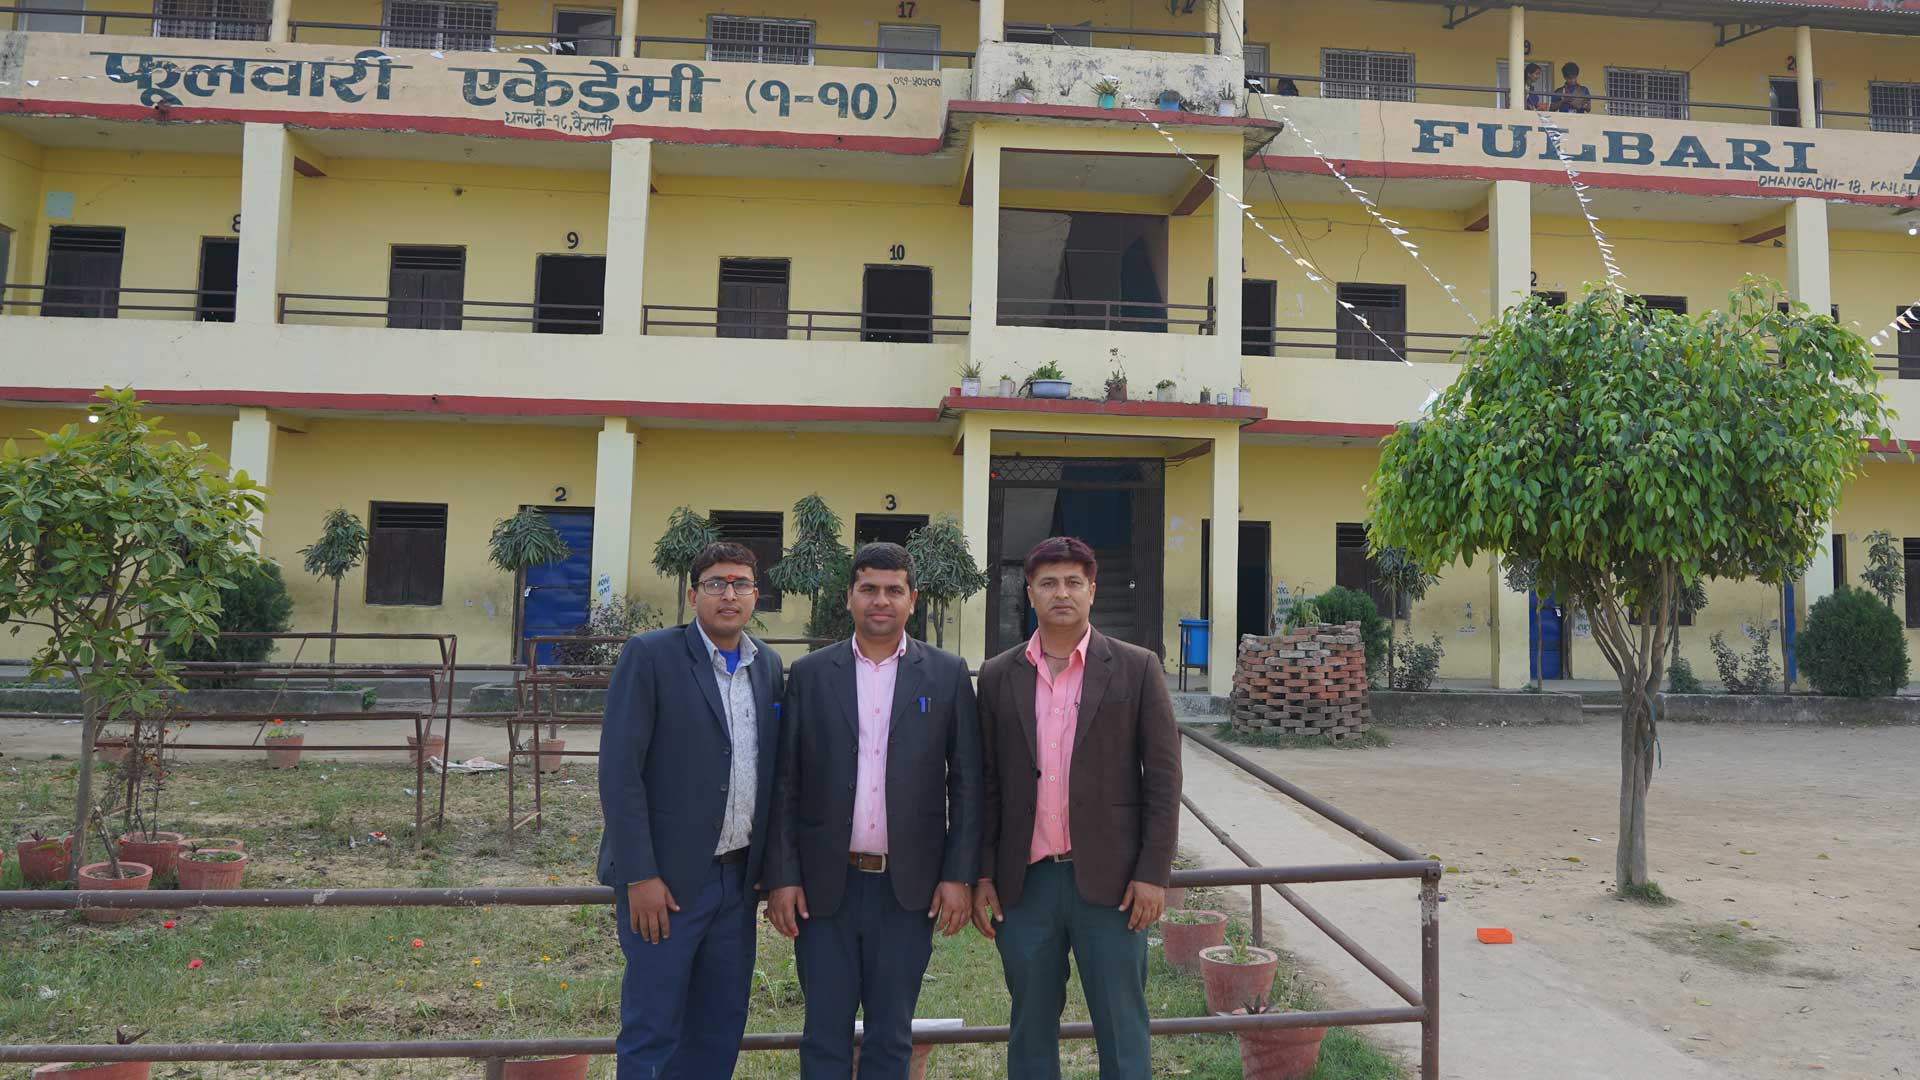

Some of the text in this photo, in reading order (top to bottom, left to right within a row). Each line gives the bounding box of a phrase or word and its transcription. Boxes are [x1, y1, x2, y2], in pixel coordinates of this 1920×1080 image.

[898, 1, 916, 18] 17
[90, 50, 413, 106] फूलवारी
[448, 57, 721, 114] एकेडेमी
[1412, 119, 1818, 174] FULBARI
[567, 231, 579, 250] 9
[889, 244, 906, 261] 10
[554, 486, 567, 502] 2
[885, 494, 897, 511] 3
